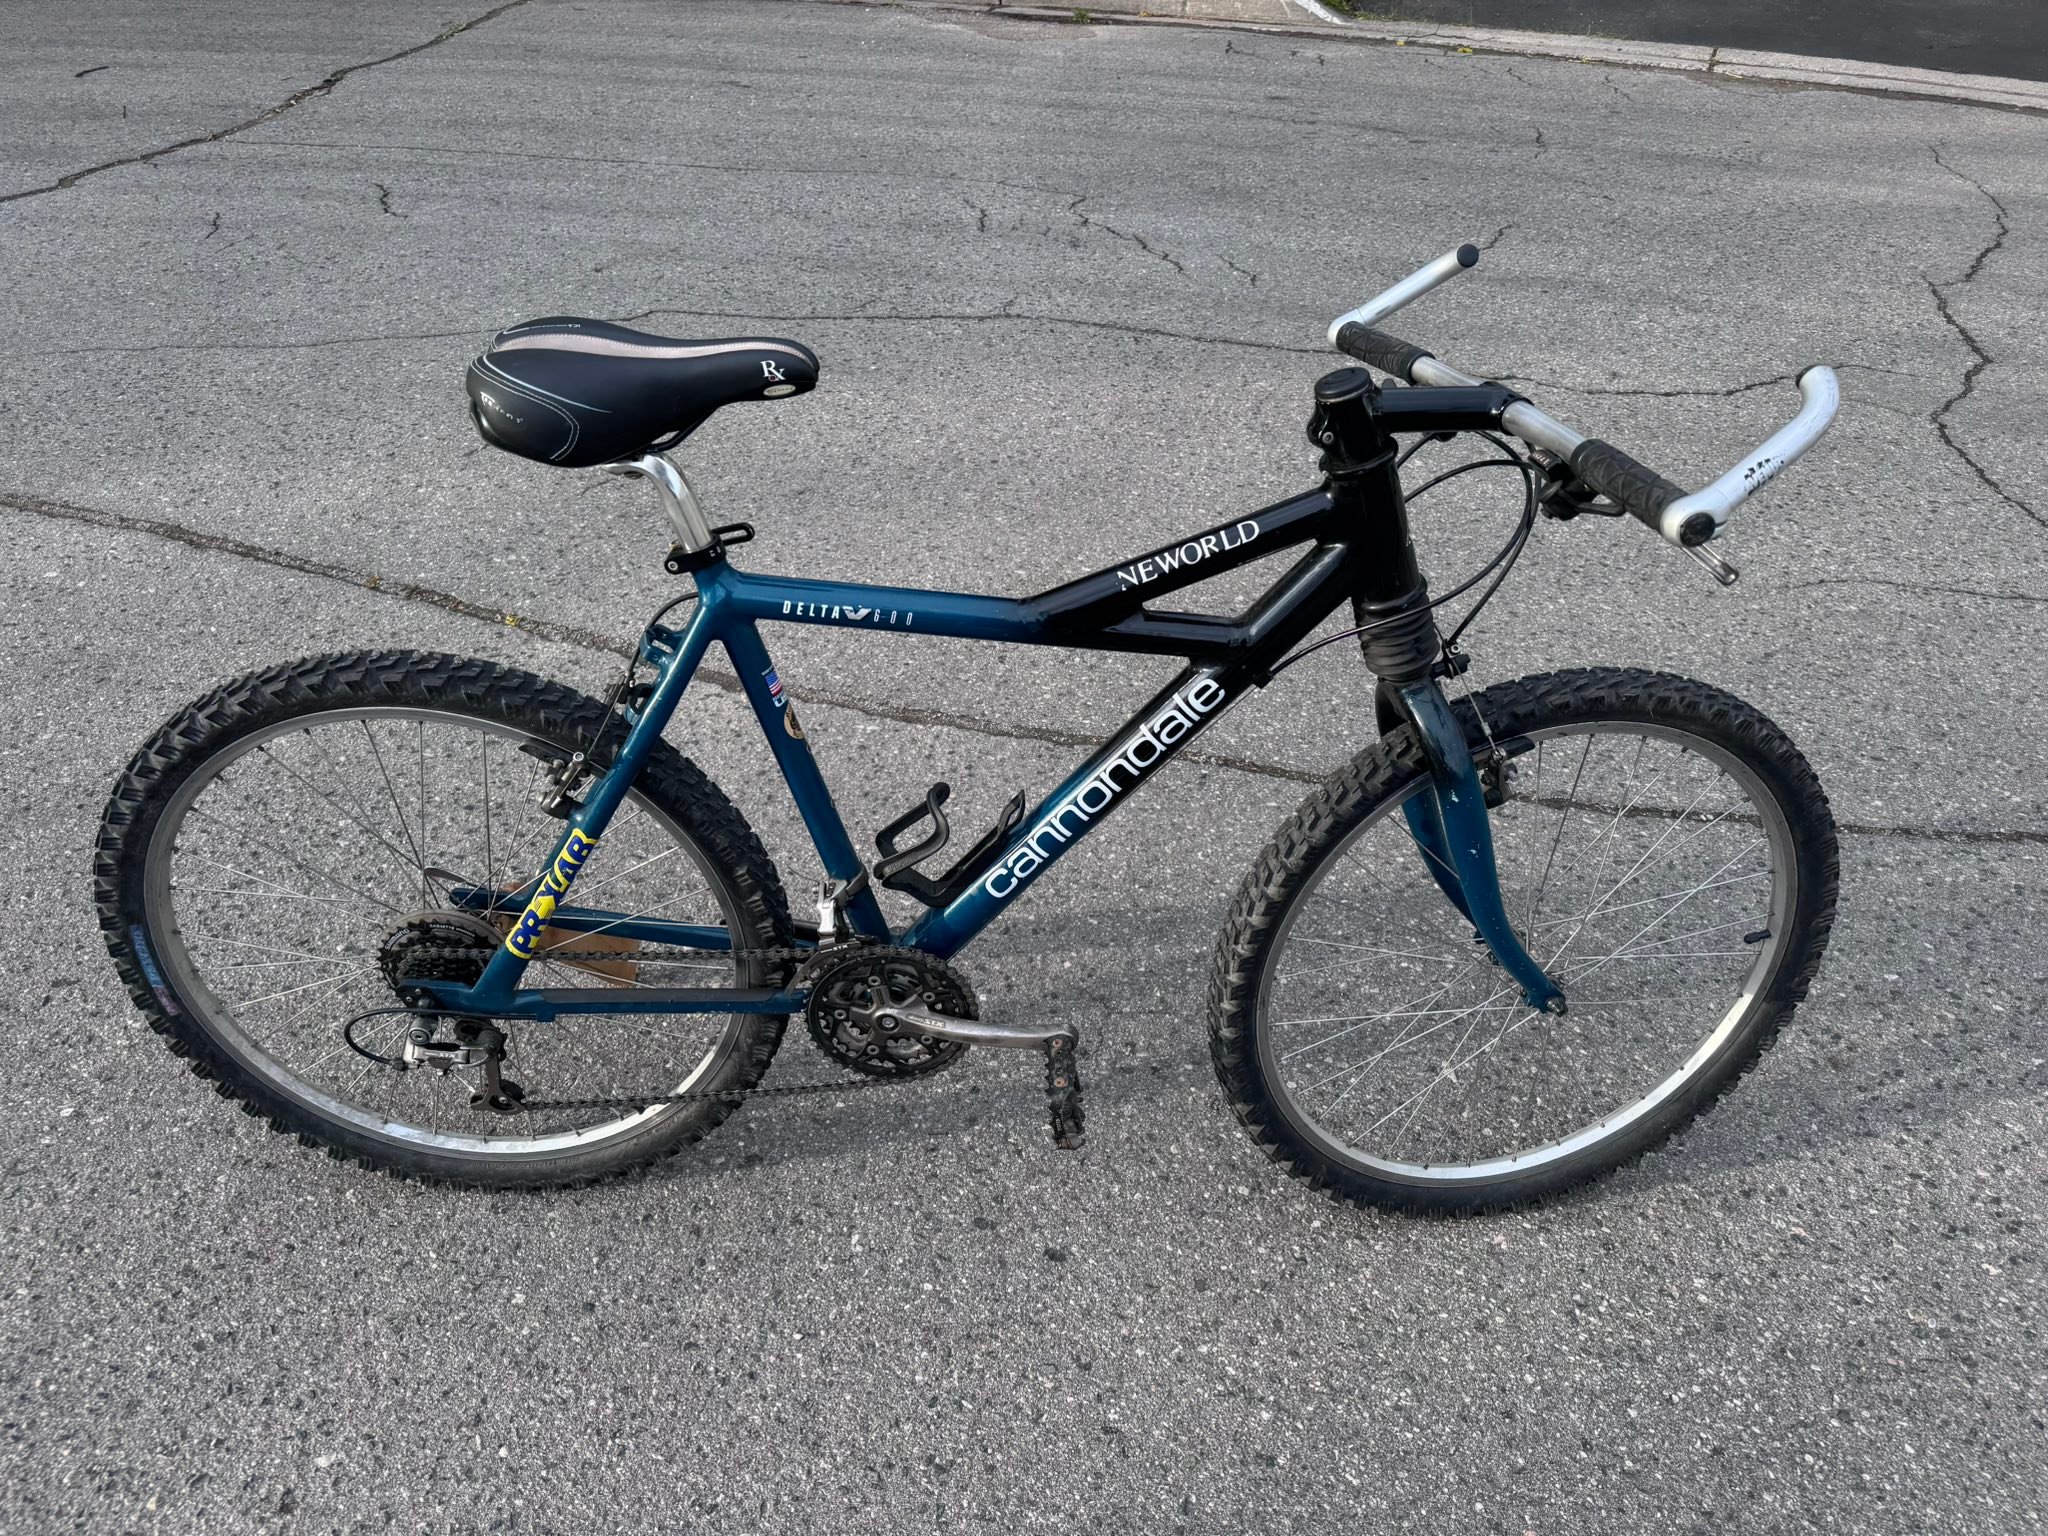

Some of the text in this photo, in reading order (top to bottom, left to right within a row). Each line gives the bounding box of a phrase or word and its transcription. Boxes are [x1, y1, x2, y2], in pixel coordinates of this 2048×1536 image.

[1115, 519, 1260, 592] NEWORLD
[873, 608, 913, 627] 600
[984, 678, 1226, 898] cannondale
